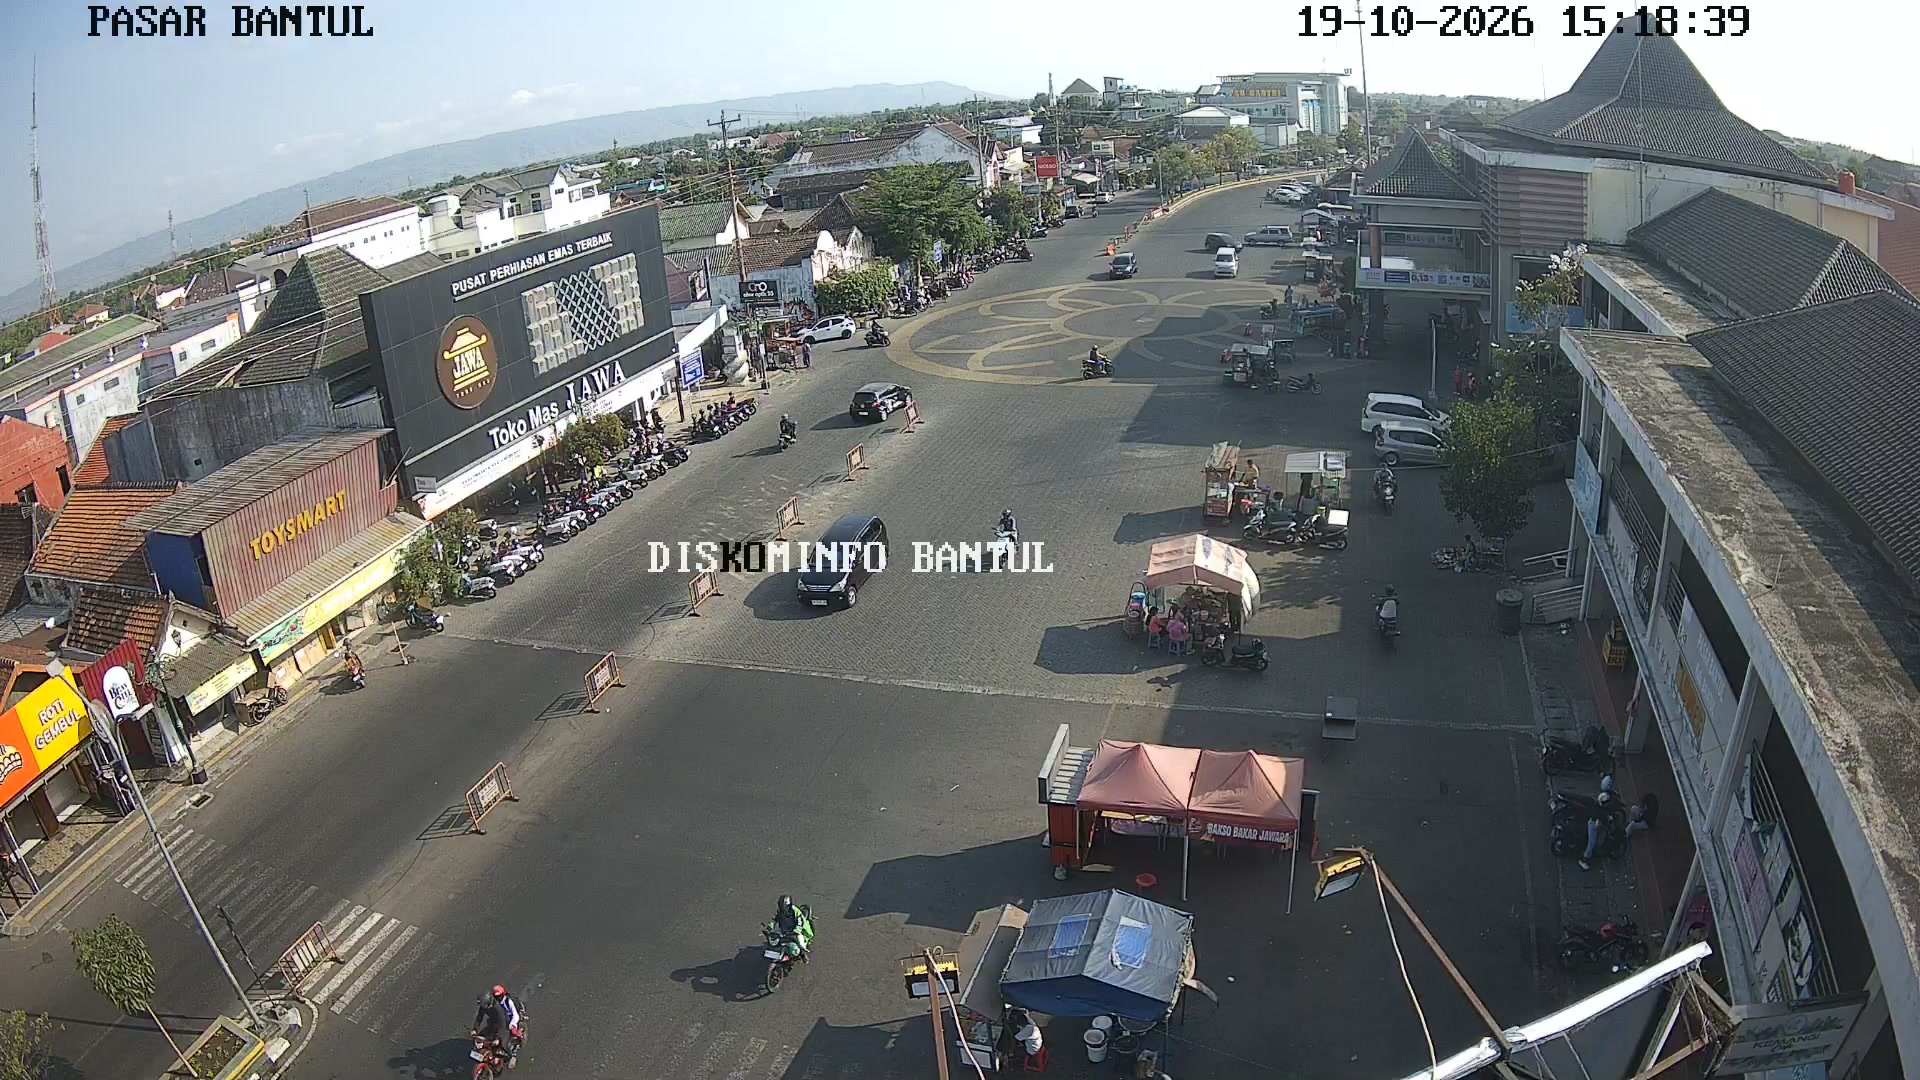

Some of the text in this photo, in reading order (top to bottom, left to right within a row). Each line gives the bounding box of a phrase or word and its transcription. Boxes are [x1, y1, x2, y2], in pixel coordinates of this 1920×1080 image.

[452, 232, 613, 296] PUSAT PERHIASAN EMAS TERBAIK
[451, 347, 487, 380] JAWA
[488, 417, 528, 450] Toko
[528, 401, 560, 431] Mas
[565, 359, 627, 411] JAWA
[249, 489, 346, 562] TOYSMART
[38, 697, 65, 726] ROTI
[34, 710, 82, 750] GEMBUL
[1207, 823, 1232, 837] BAKSO
[1233, 827, 1258, 841] BAKAR
[1259, 829, 1290, 843] JAWARA
[1753, 1033, 1821, 1049] KEMANGI
